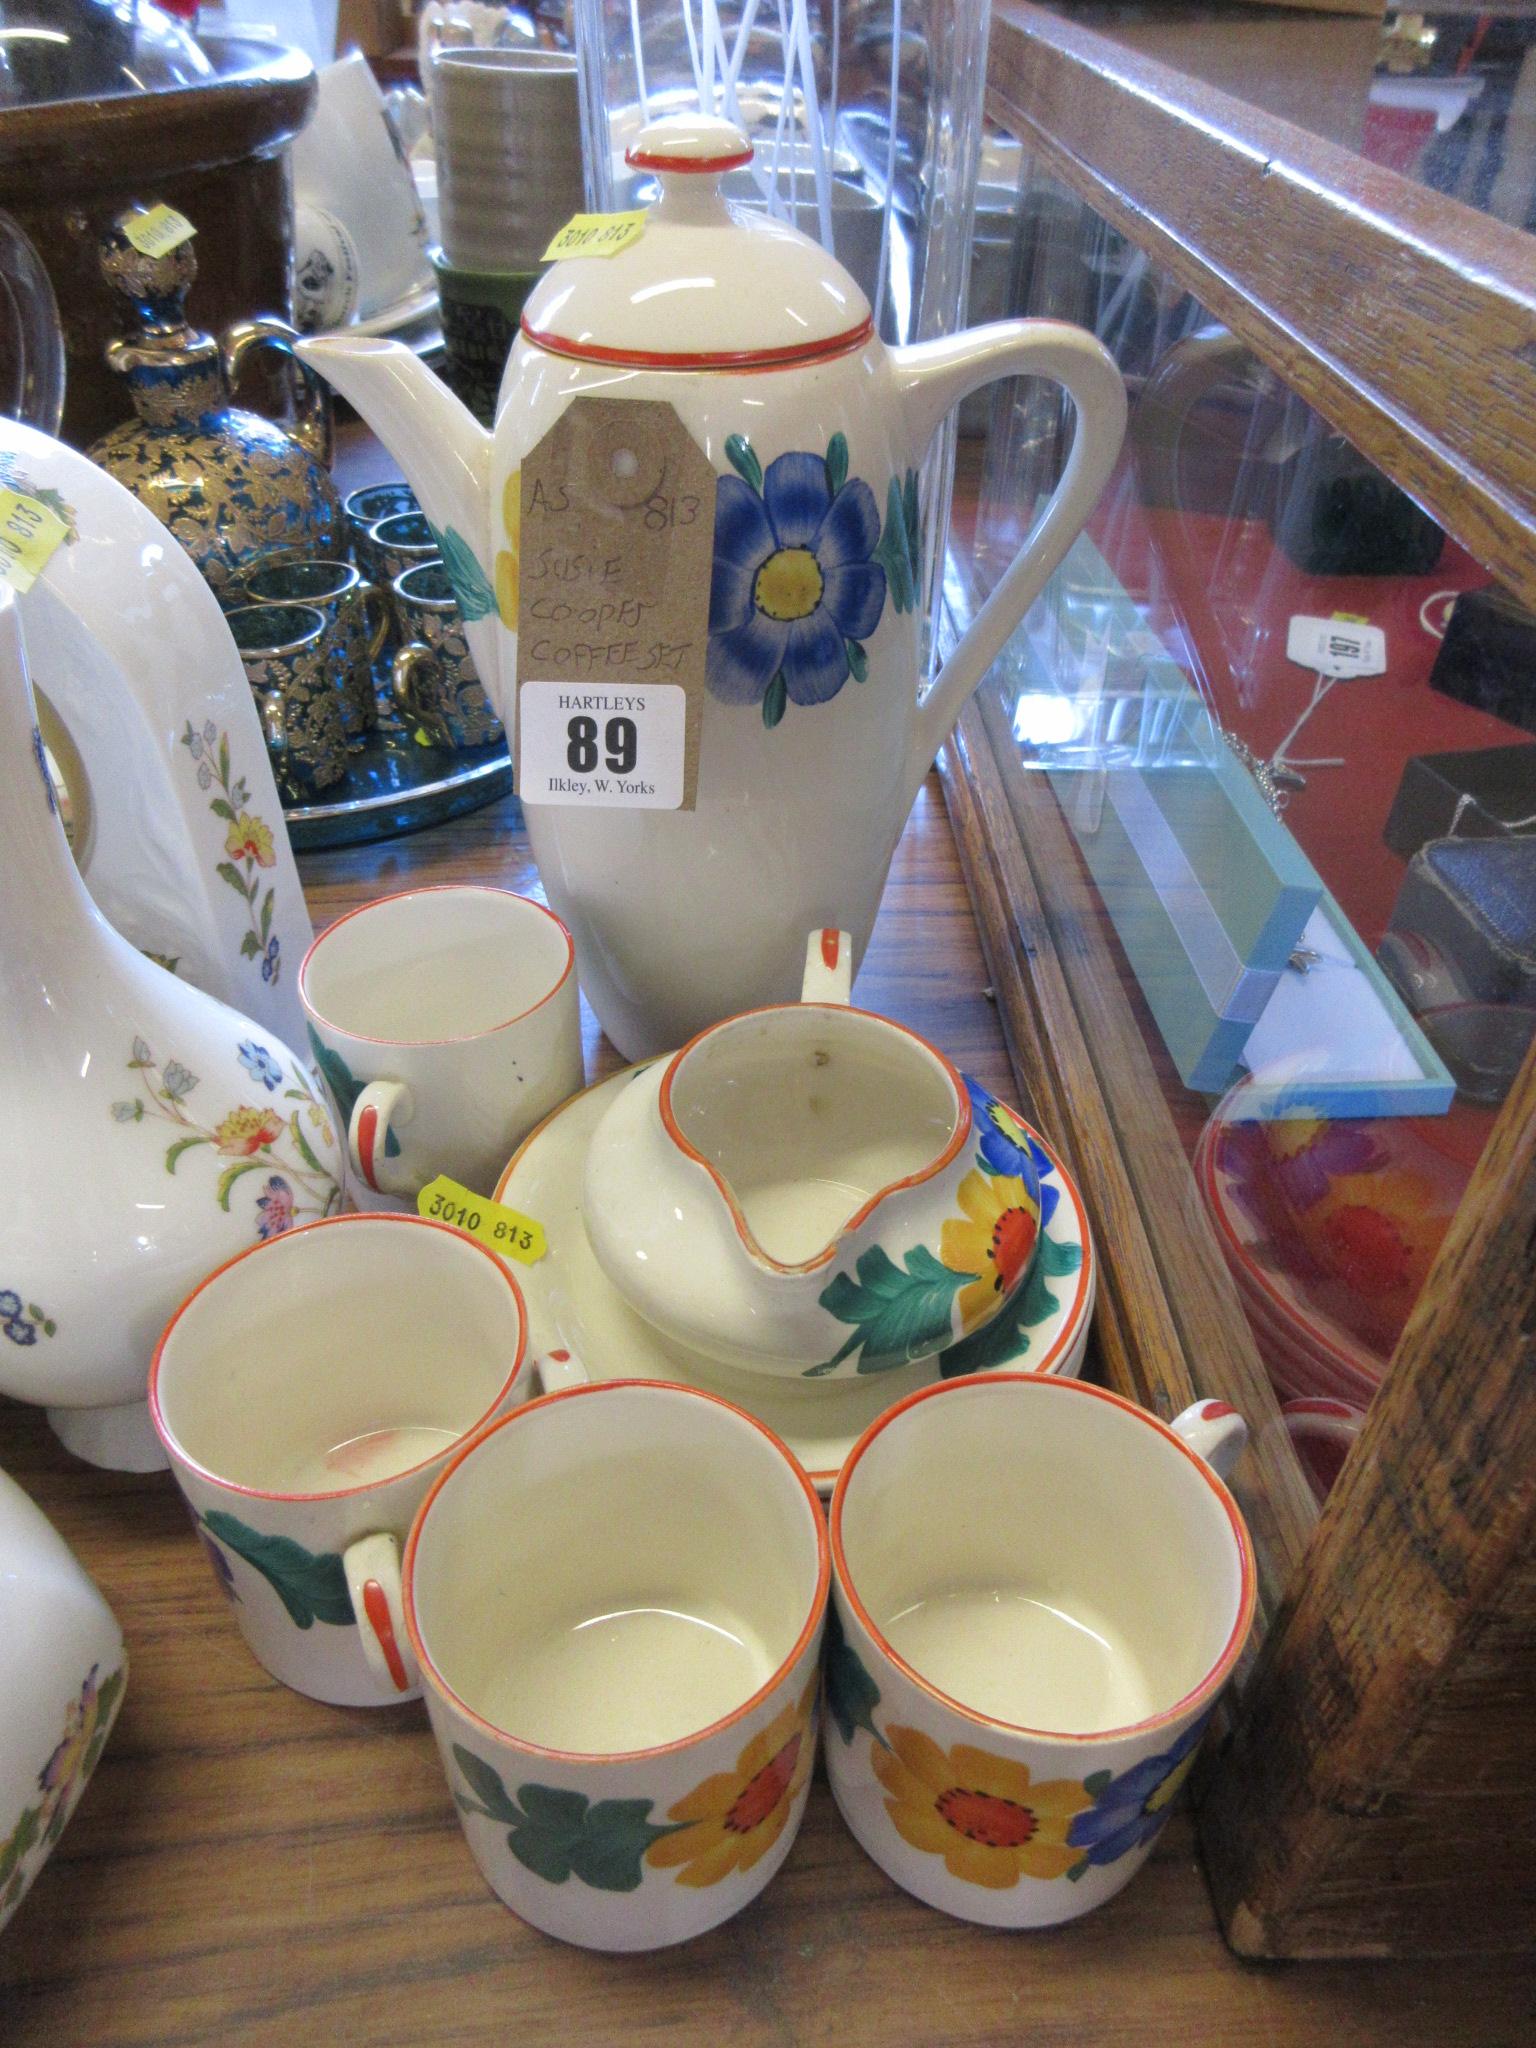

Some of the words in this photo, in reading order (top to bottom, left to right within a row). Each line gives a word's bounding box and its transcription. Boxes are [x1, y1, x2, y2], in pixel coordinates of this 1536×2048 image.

[558, 229, 599, 248] 3010
[598, 222, 635, 241] 813
[7, 503, 43, 538] 813
[644, 496, 700, 531] 813
[530, 640, 639, 672] COFFEE
[636, 641, 693, 670] SET
[558, 695, 646, 711] HARTLEYS
[567, 715, 638, 774] 89
[549, 778, 591, 795] Ilkley,
[594, 779, 613, 793] W.
[616, 780, 655, 795] Yorks
[429, 1194, 481, 1230] 3010
[493, 1222, 533, 1250] 813
